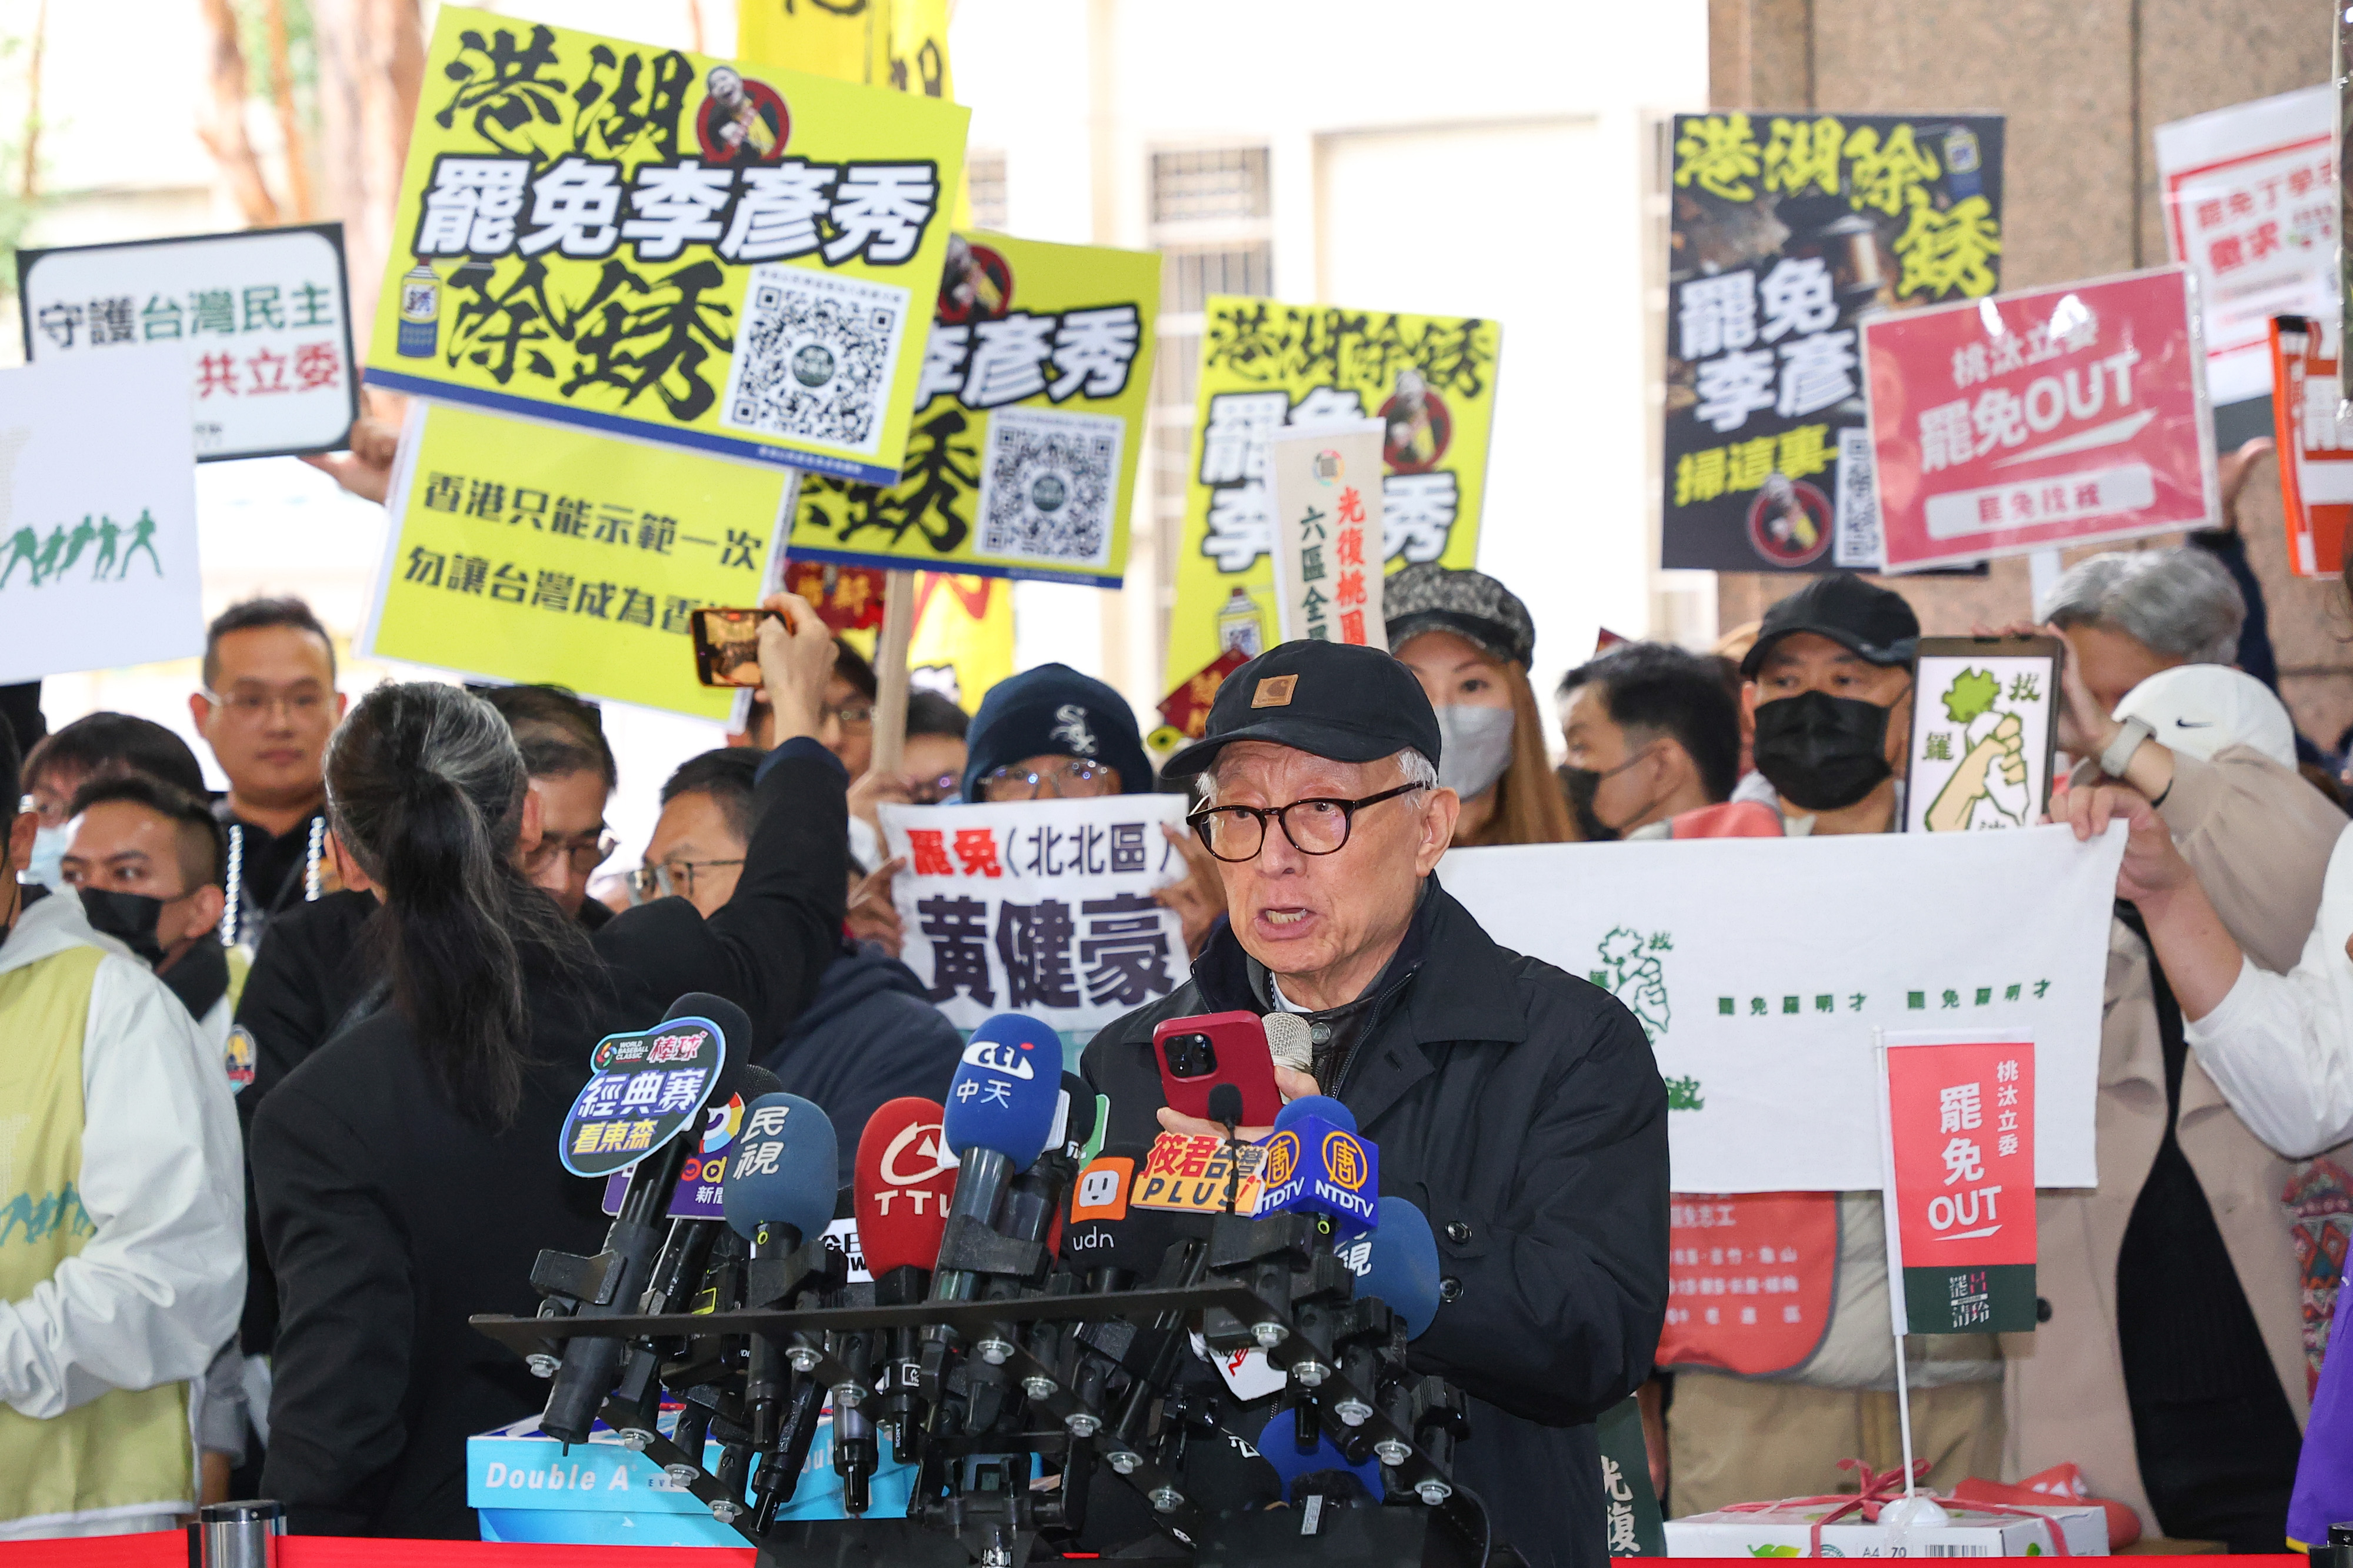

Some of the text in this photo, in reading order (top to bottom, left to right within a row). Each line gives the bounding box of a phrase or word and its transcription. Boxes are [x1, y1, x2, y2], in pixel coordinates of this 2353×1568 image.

[413, 152, 939, 265] 罷免李彥秀
[38, 280, 334, 348] 守護台灣民主
[1679, 256, 1840, 361] 罷免
[196, 341, 340, 398] 共立委
[1919, 353, 2141, 473] 罷免OUT
[424, 471, 763, 572] 香港只能示範一次
[1202, 471, 1458, 572] 李秀
[404, 546, 716, 634] 勿讓台灣成為香
[917, 893, 1175, 1009] 黃健豪
[1718, 979, 2051, 1016] 罷免羅明才 罷免羅明才
[616, 1052, 642, 1060] CLASSIC
[647, 1032, 708, 1063] 棒球
[577, 1069, 706, 1117] 經典賽
[956, 1079, 1012, 1108] 中天
[1997, 1060, 2019, 1157] 桃汰立委
[573, 1119, 658, 1153] 看東森
[734, 1106, 789, 1179] 民視
[1940, 1082, 1984, 1186] 罷免
[1261, 1177, 1305, 1213] TDTV
[1315, 1180, 1374, 1218] NTDTV
[1928, 1186, 2002, 1232] OUT
[1073, 1226, 1114, 1252] udn
[485, 1462, 629, 1490] Double A
[1601, 1455, 1641, 1558] 光復
